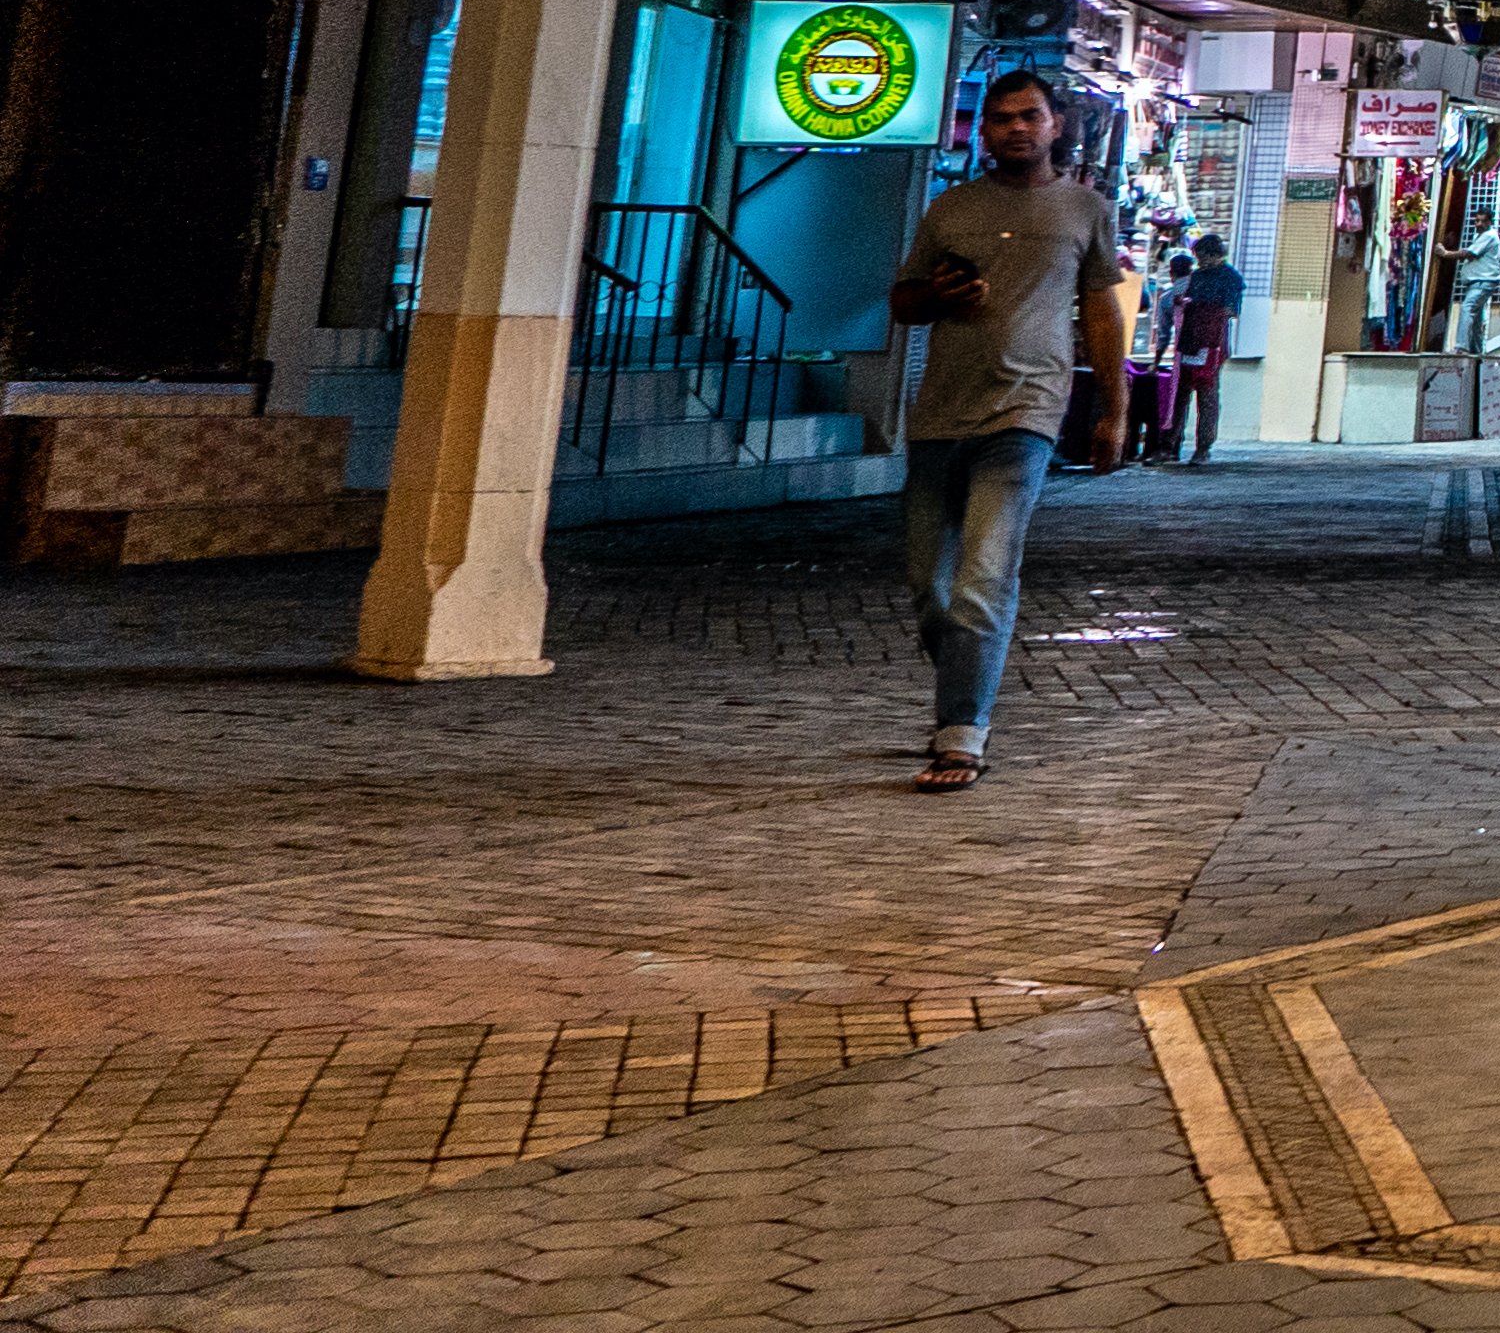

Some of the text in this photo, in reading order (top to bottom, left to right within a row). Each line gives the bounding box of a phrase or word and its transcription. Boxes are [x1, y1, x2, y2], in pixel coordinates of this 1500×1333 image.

[778, 70, 912, 136] OMANI HALWA CORNER
[1361, 94, 1437, 118] صراف
